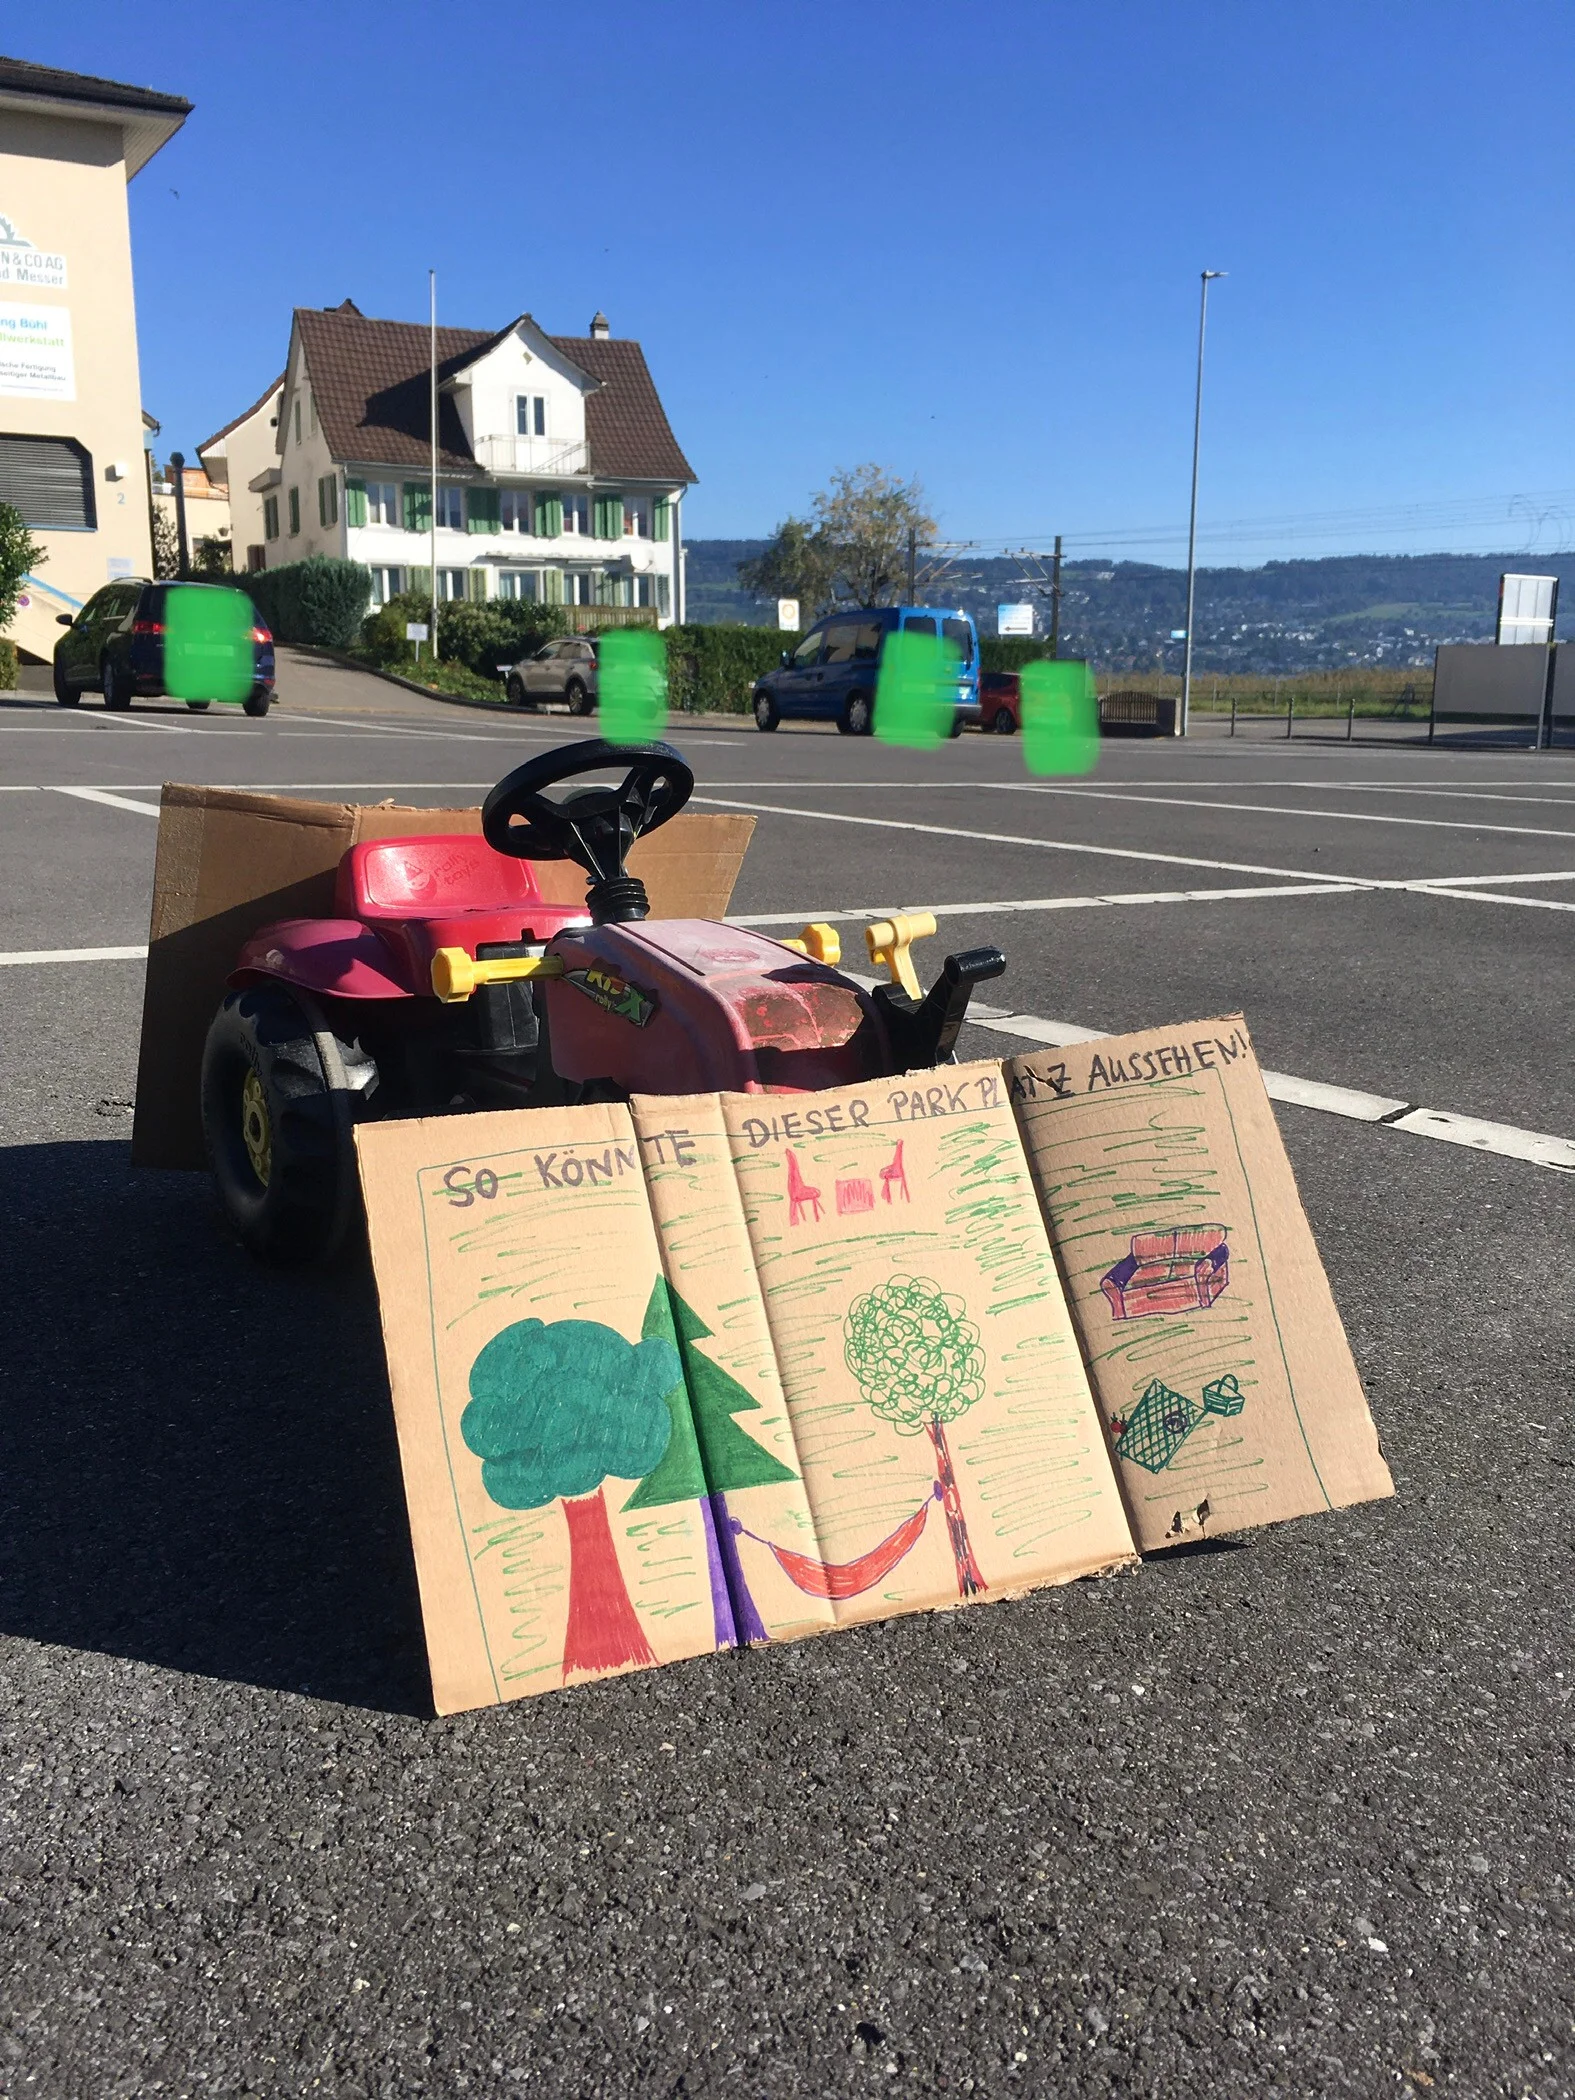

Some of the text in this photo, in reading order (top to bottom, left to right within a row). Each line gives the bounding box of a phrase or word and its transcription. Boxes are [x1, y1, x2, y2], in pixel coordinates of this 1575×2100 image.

[12, 252, 21, 265] &
[46, 256, 63, 270] AG
[17, 268, 63, 284] Messer
[117, 492, 125, 505] 2
[434, 853, 468, 877] rolly
[444, 859, 480, 884] toys
[442, 1165, 499, 1208] SO
[533, 1129, 698, 1189] KÖNNTE
[741, 1098, 869, 1149] DIESER
[1087, 1029, 1250, 1091] AUSSEHEN!
